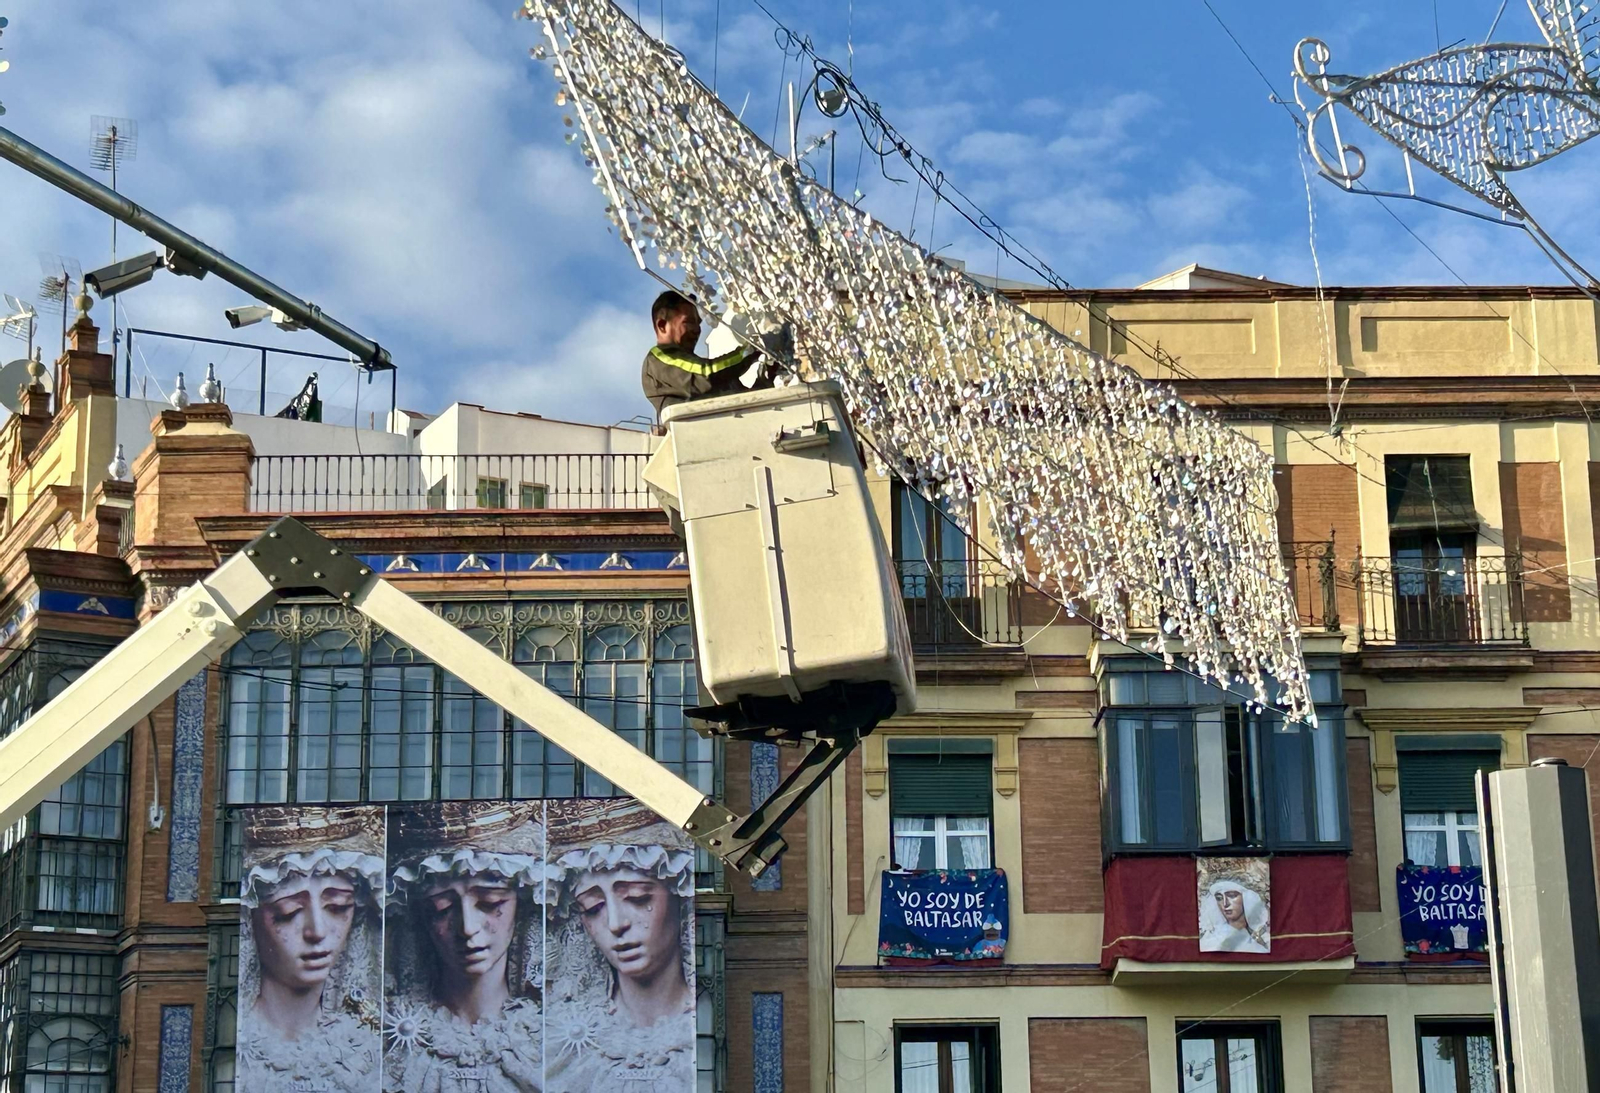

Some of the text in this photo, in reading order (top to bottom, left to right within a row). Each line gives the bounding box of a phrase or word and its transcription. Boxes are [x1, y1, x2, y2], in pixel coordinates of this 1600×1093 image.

[897, 890, 985, 909] YO SOY DE
[1411, 884, 1487, 903] YO SOY D
[904, 910, 984, 928] BALTASAR
[1419, 903, 1487, 922] BALTASA
